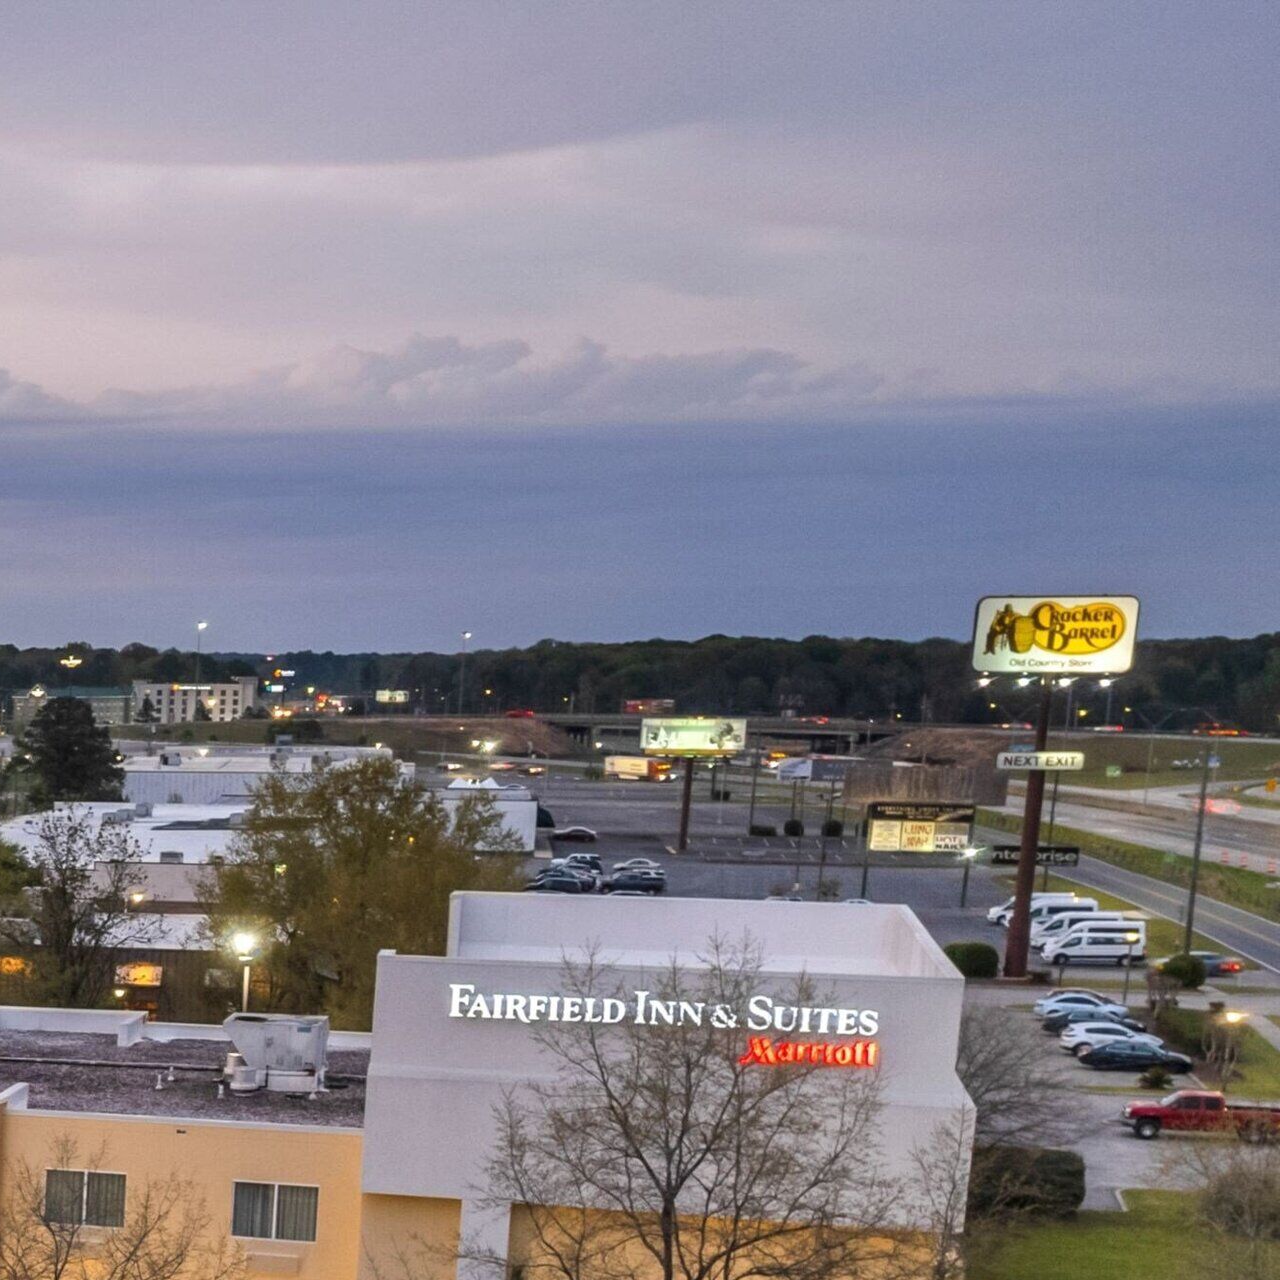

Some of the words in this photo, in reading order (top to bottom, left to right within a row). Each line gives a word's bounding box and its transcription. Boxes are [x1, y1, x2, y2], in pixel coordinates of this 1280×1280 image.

[1008, 657, 1026, 668] Old
[1003, 755, 1040, 768] NEXT
[1045, 755, 1077, 768] EXIT
[448, 983, 627, 1024] FAIRFIELD
[634, 990, 706, 1028] INN
[710, 1003, 740, 1029] &
[747, 995, 879, 1036] SUITES
[740, 1037, 879, 1067] Marriott
